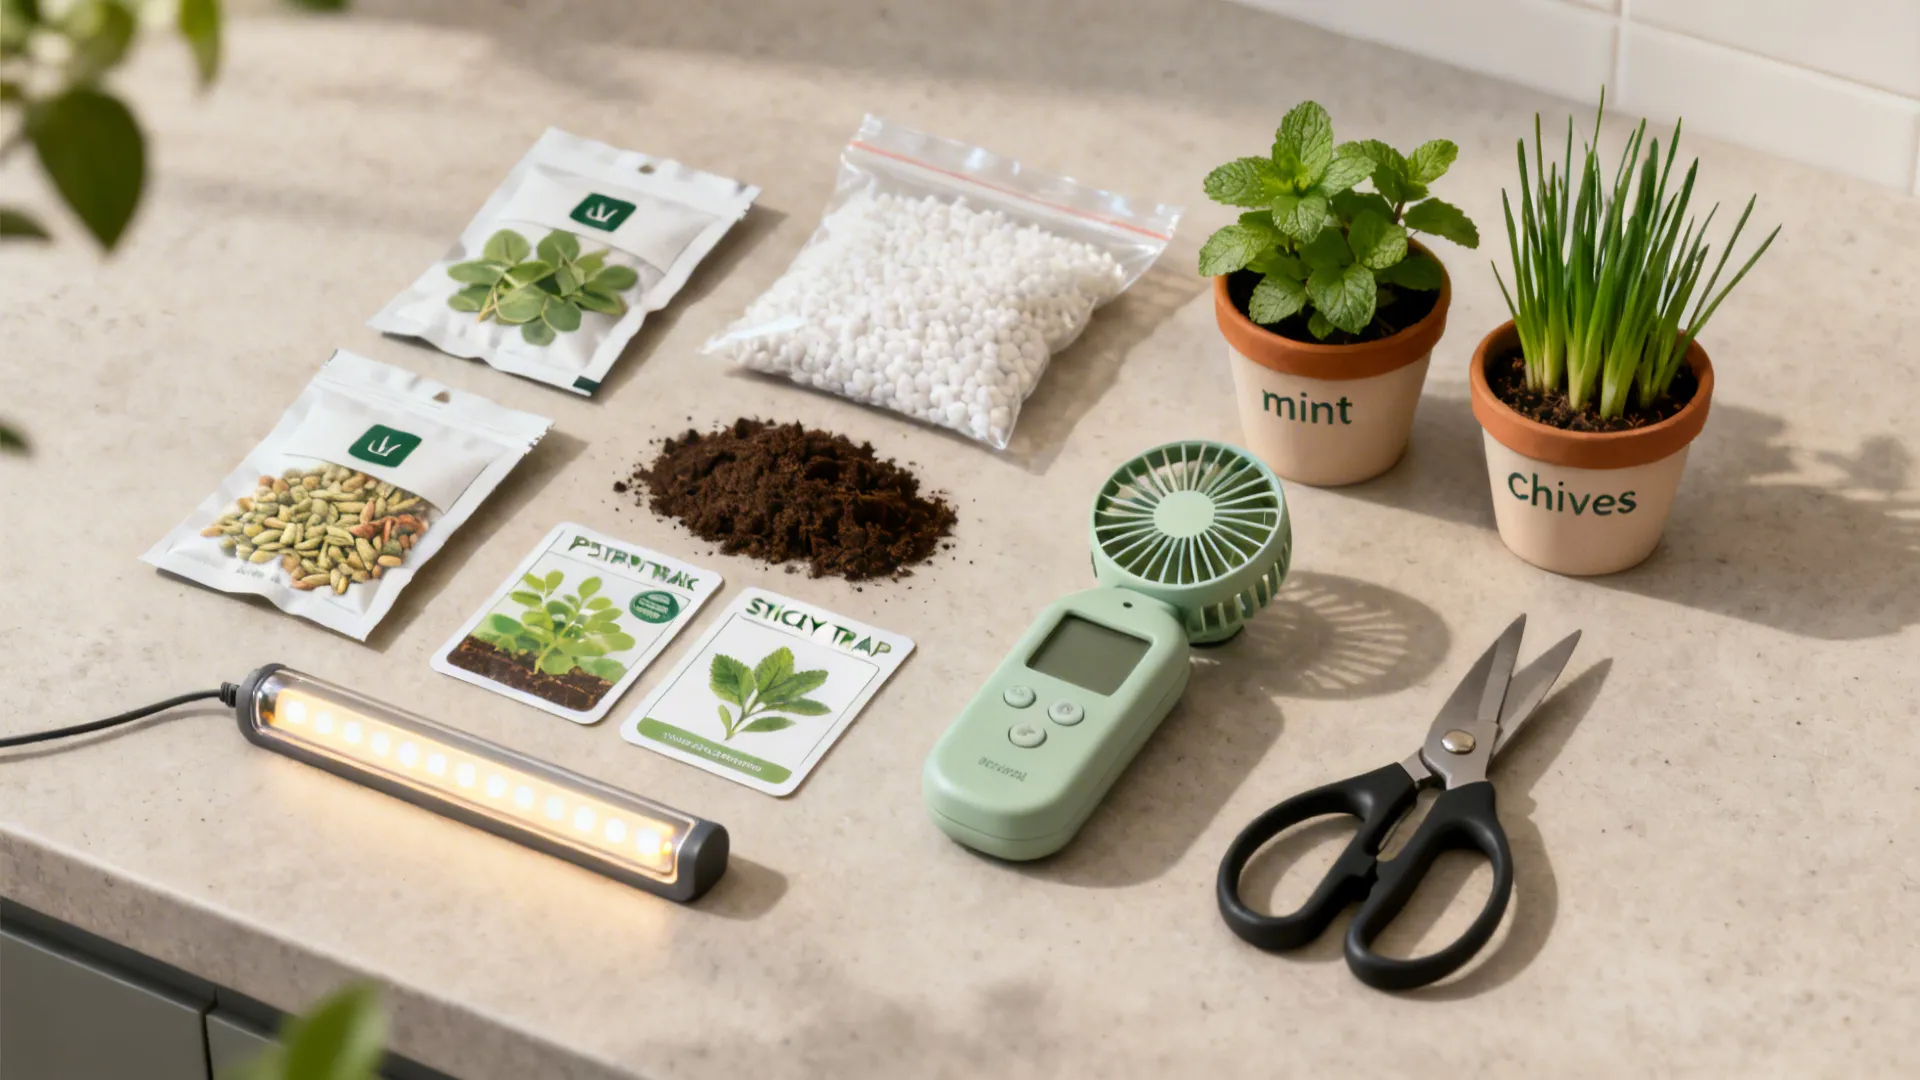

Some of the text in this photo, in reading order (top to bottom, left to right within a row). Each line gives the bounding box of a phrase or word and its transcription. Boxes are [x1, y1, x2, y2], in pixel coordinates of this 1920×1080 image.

[1262, 389, 1353, 425] mint
[1507, 472, 1637, 516] Chives
[832, 624, 891, 657] TRAP
